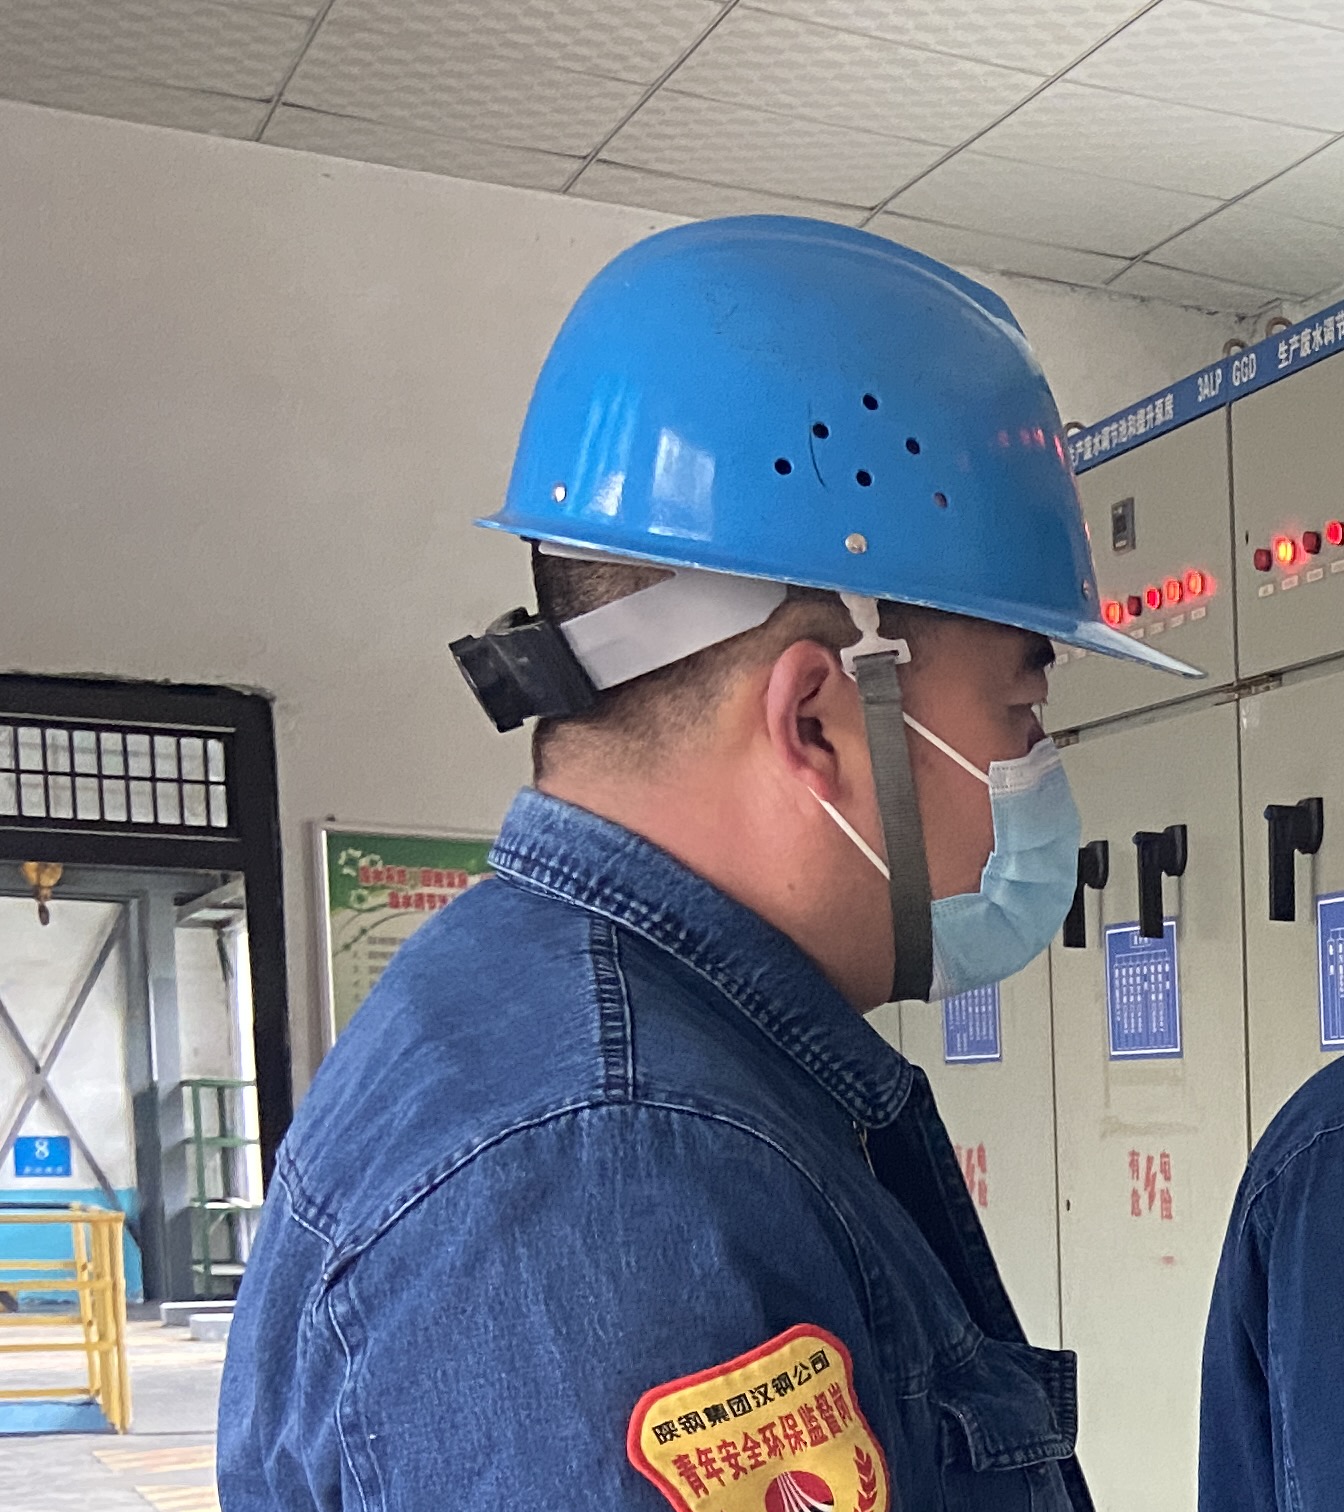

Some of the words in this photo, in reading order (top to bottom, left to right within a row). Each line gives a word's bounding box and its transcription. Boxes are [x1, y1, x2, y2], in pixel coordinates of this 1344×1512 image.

[1232, 352, 1257, 387] GGD
[35, 1139, 49, 1160] 8
[651, 1348, 830, 1445] 陕钢集团汉钢公司
[671, 1381, 853, 1499] 青年安全环保监督岗
